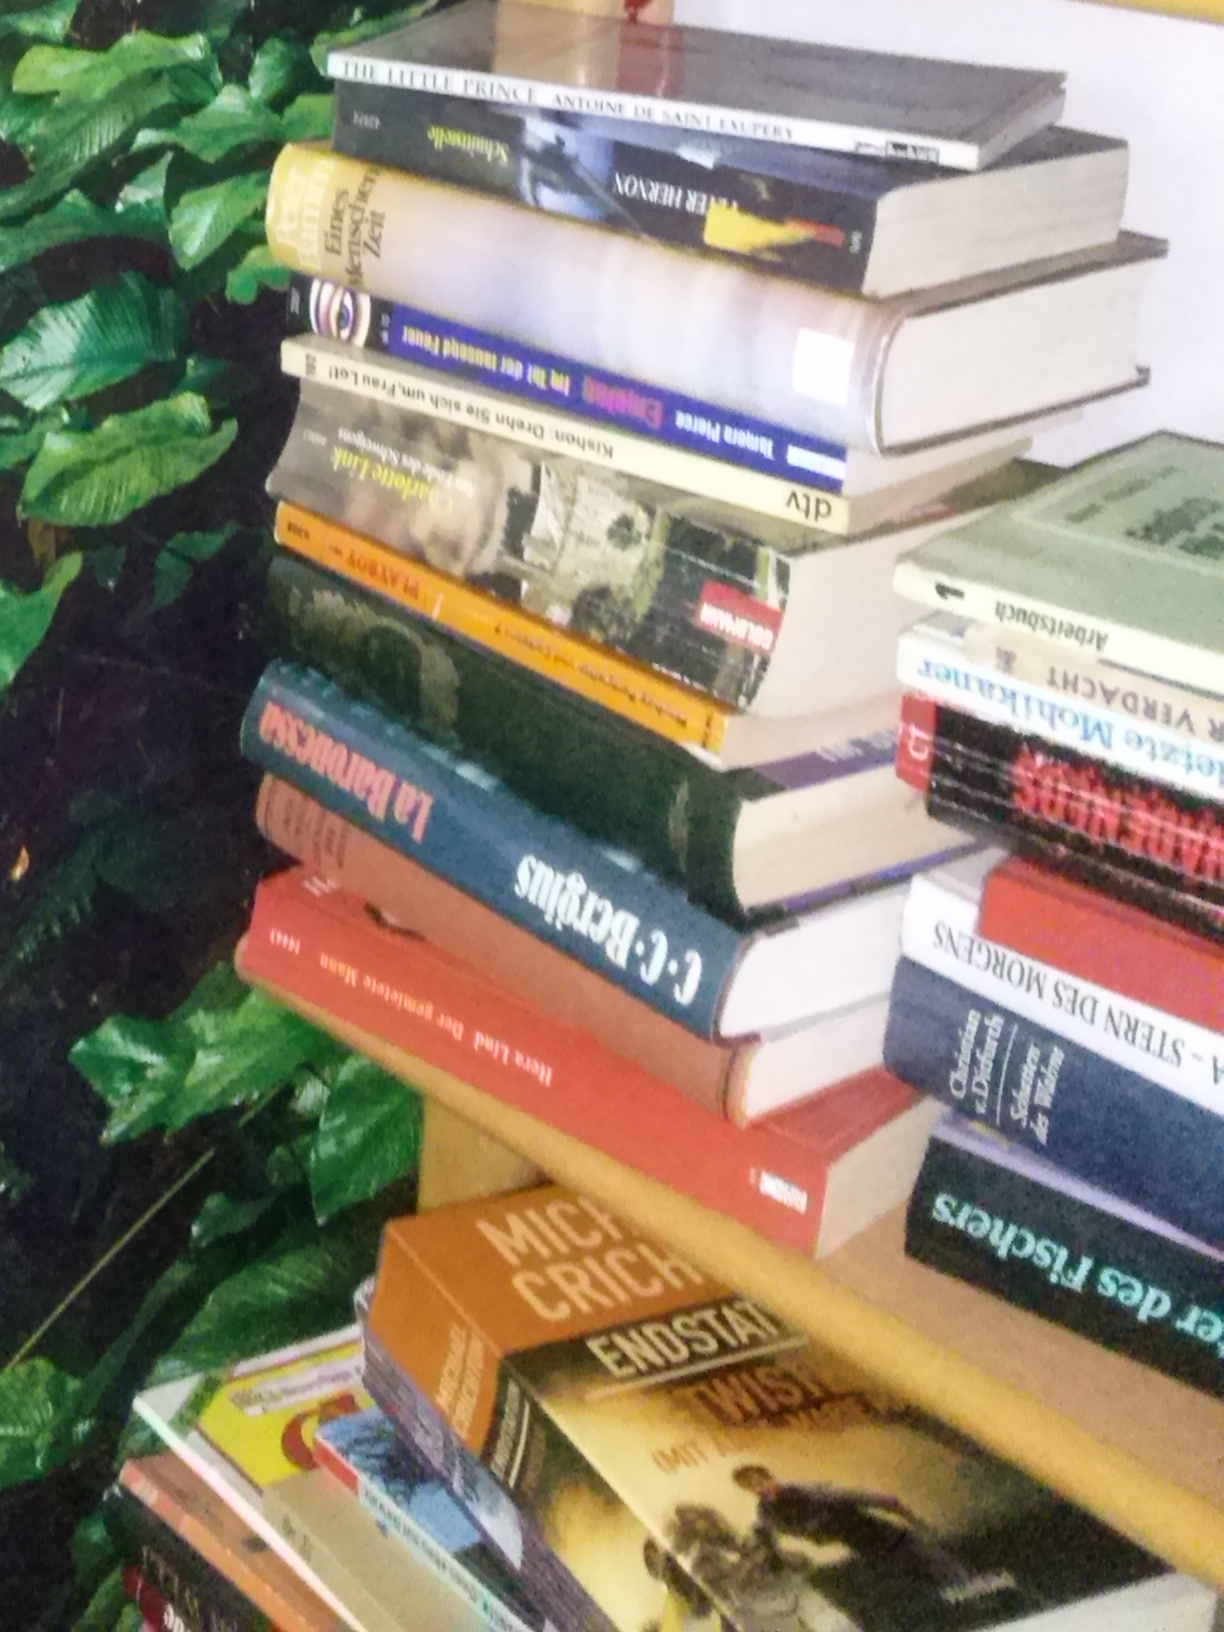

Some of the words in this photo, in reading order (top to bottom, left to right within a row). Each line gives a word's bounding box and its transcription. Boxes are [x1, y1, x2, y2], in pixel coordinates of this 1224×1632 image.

[342, 59, 377, 80] THE
[387, 65, 451, 92] LITTLE
[462, 77, 537, 104] PRINCE
[552, 91, 626, 116] ANTOINE
[633, 103, 655, 121] DE
[662, 109, 712, 130] SAINT
[426, 124, 510, 165] Schnittstelle
[613, 170, 683, 214] HERNON
[322, 186, 350, 258] Eines
[361, 209, 387, 261] Zeit
[401, 324, 441, 357] Feuer
[442, 336, 498, 373] tausend
[327, 364, 359, 386] Lot!
[500, 354, 524, 382] der
[526, 360, 548, 390] Tal
[549, 368, 571, 397] Im
[429, 393, 462, 415] sich
[465, 404, 491, 425] Sie
[496, 411, 545, 441] Drehn
[552, 430, 614, 460] Kishon:
[723, 423, 776, 461] Tamora
[331, 445, 373, 482] Link
[785, 489, 833, 520] dtv
[346, 548, 420, 600] PLAYBOY
[699, 602, 775, 651] GOLDMANN
[993, 599, 1109, 653] Arbeitsbuch
[917, 657, 1115, 752] Mohikaner
[1046, 666, 1196, 734] VERDACHT
[258, 700, 398, 823] Baronessa
[396, 790, 436, 845] La
[318, 952, 360, 990] Mann
[932, 919, 1052, 1000] MORGENS
[363, 974, 435, 1028] gemietete
[1051, 979, 1099, 1027] DES
[435, 1011, 466, 1042] Der
[1103, 1003, 1185, 1069] STERN
[473, 1031, 511, 1068] Lind
[513, 1050, 553, 1087] Hera
[949, 1008, 982, 1099] Christian
[1010, 1042, 1041, 1130] Schatten
[1029, 1111, 1050, 1147] des
[931, 1189, 1095, 1293] Fischers
[1096, 1264, 1173, 1324] des
